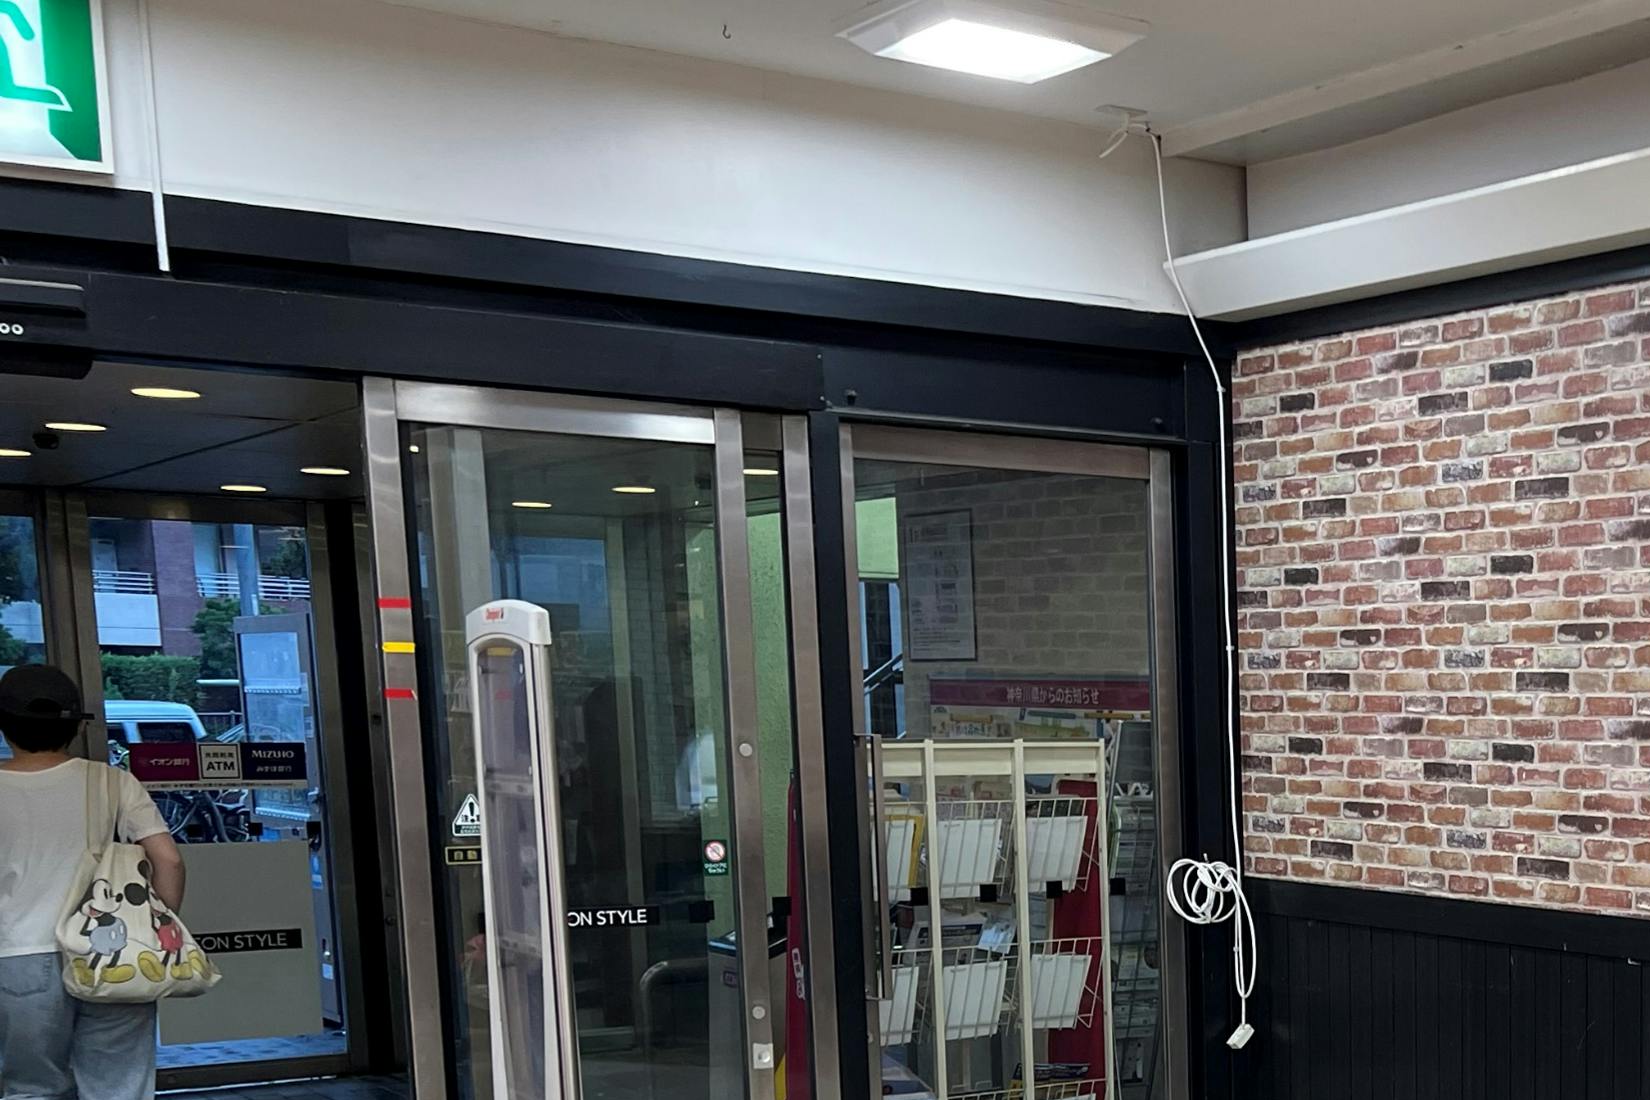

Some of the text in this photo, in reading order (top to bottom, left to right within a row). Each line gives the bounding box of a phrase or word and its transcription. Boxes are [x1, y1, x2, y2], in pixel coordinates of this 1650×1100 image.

[206, 761, 235, 771] ATM
[596, 908, 647, 925] STYLE
[195, 932, 287, 950] ON STYLE
